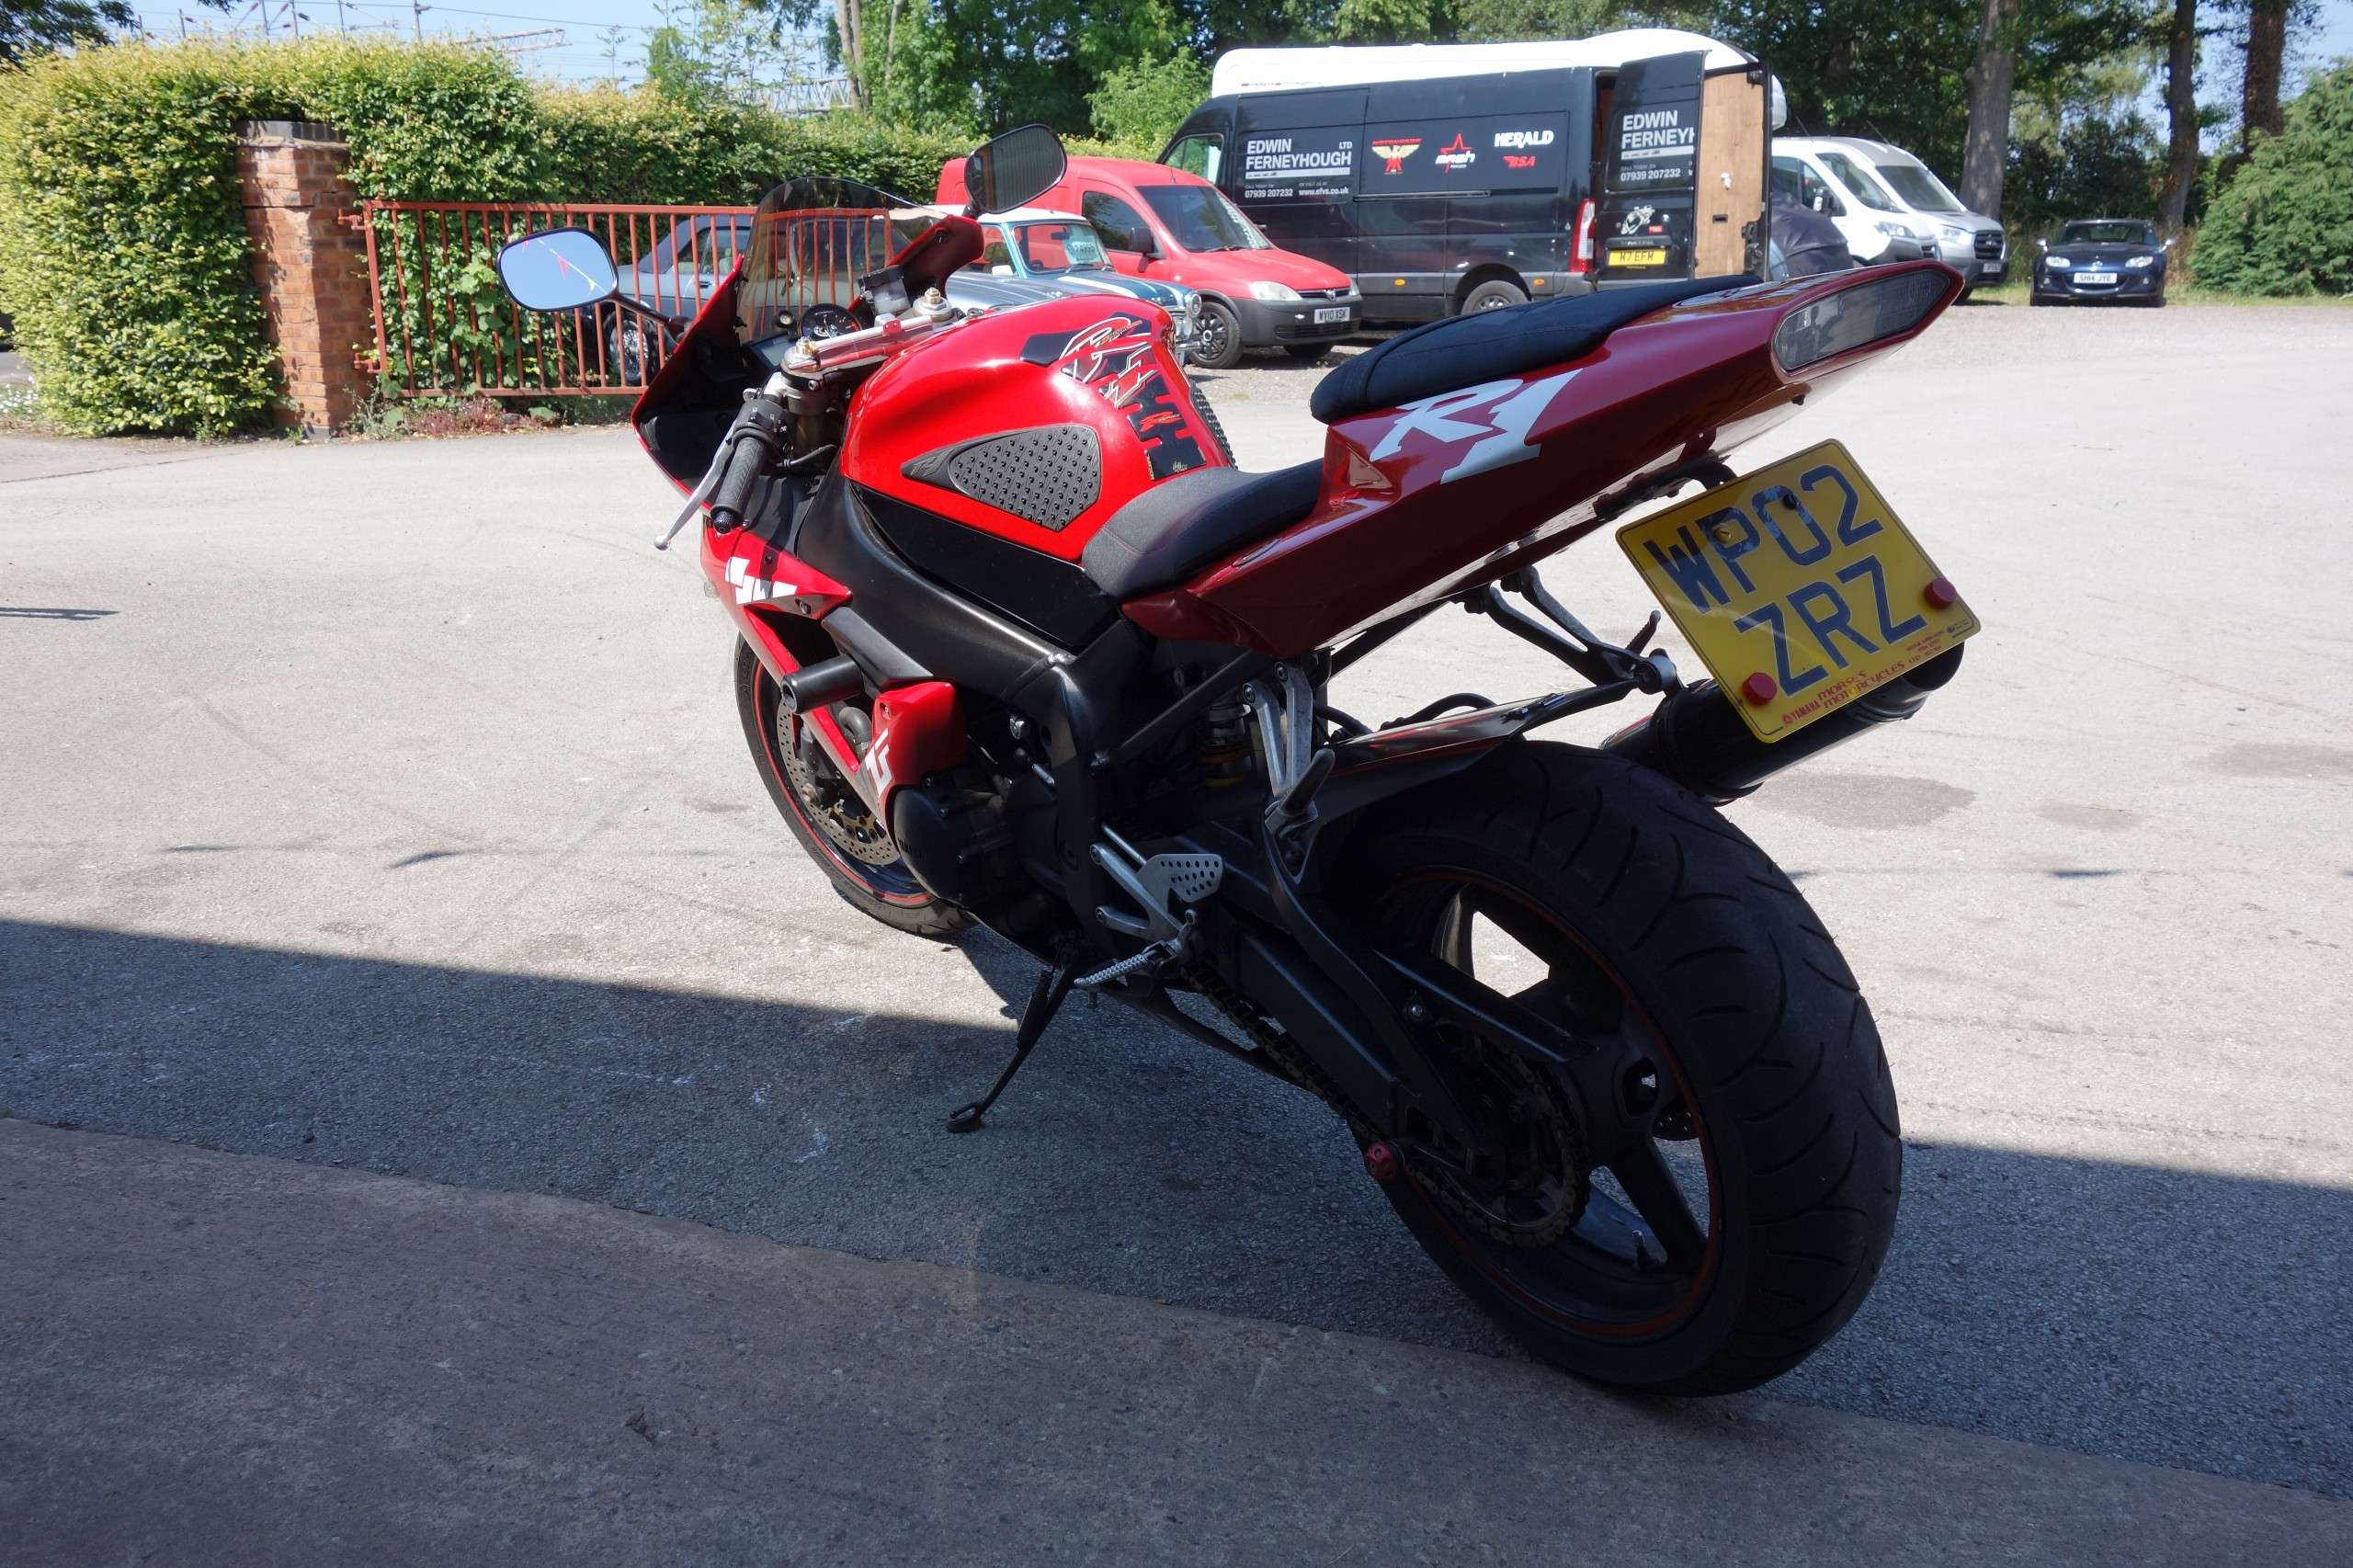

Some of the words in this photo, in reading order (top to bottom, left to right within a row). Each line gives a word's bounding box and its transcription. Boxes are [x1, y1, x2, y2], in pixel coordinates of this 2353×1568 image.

[1622, 109, 1678, 131] EDWIN
[1246, 138, 1292, 154] EDWIN
[1338, 141, 1353, 150] LTD
[1494, 130, 1554, 149] HERALD
[1245, 151, 1352, 170] FERNEYHOUGH
[1503, 154, 1537, 169] BSA
[1620, 170, 1647, 182] 07939
[1647, 167, 1681, 180] 207232
[1245, 189, 1267, 199] 07939
[1267, 188, 1293, 198] 207232
[1643, 464, 1884, 615] WP02
[1733, 554, 1928, 698] ZRZ
[1792, 699, 1821, 721] YAMAHA
